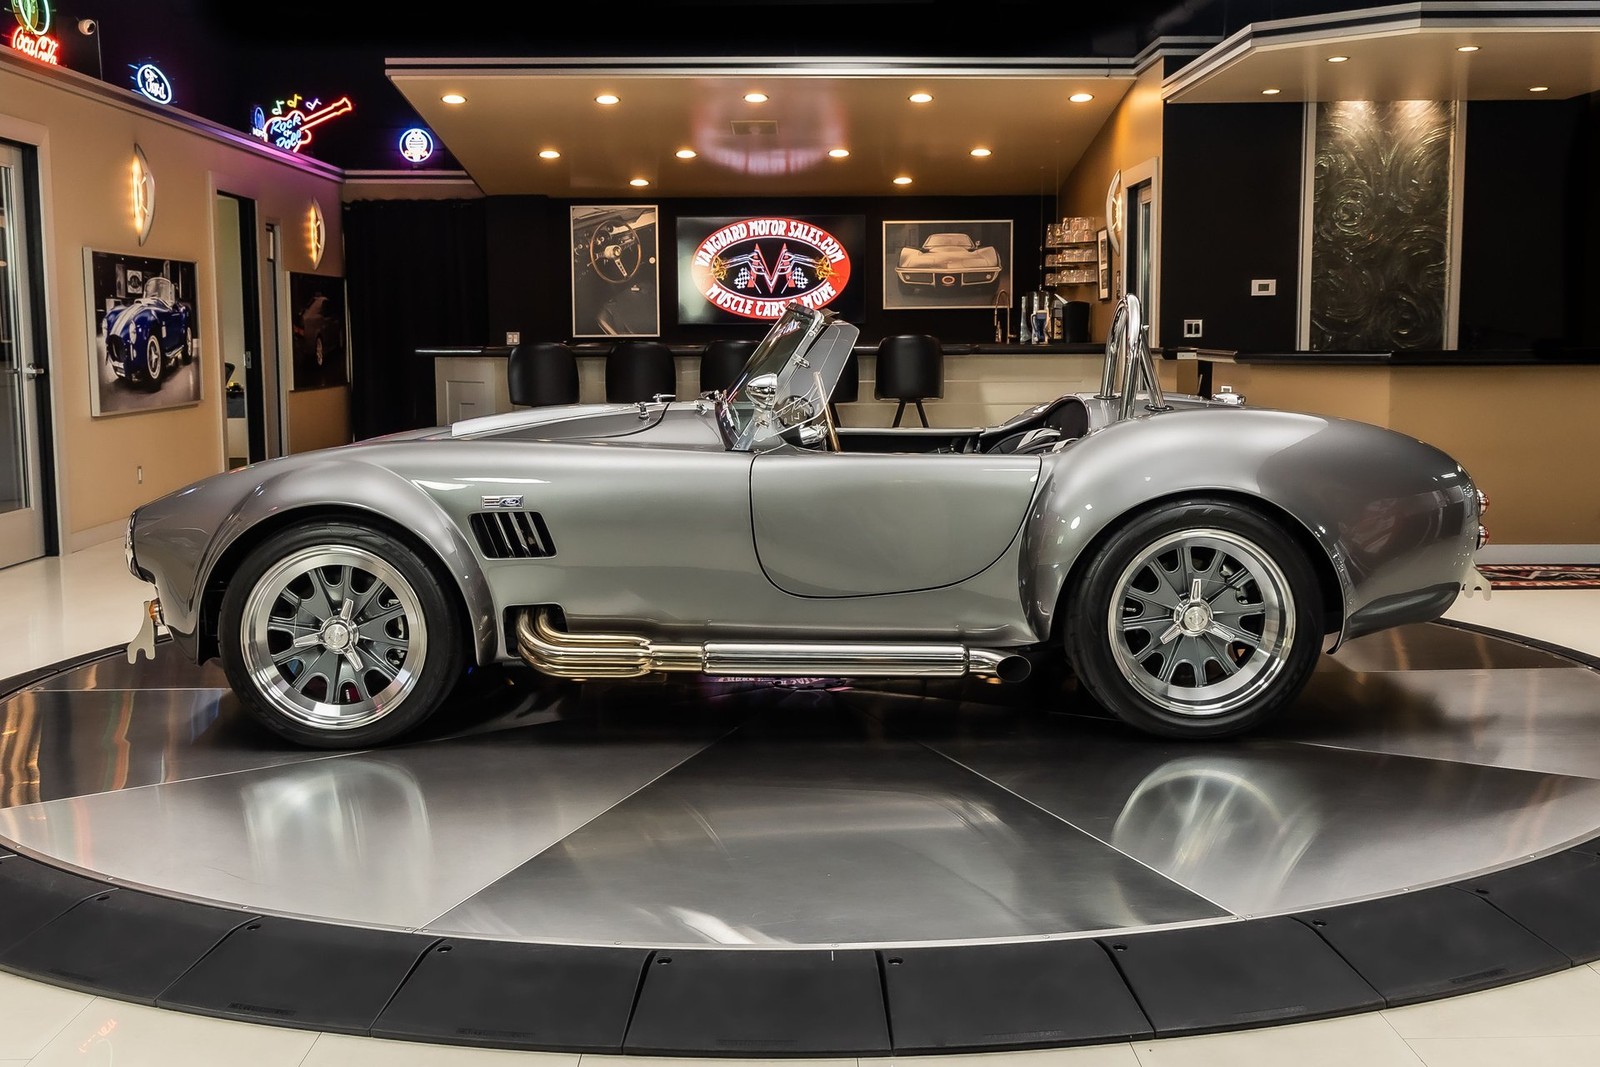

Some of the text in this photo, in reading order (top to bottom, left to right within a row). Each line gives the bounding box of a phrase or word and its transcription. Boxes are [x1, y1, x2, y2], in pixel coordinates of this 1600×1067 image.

[144, 68, 167, 99] Ford
[270, 113, 302, 135] Rock
[695, 220, 845, 266] VANGUARD MOTOR SALES.COM
[705, 281, 836, 317] MUSCLE CARS MORE
